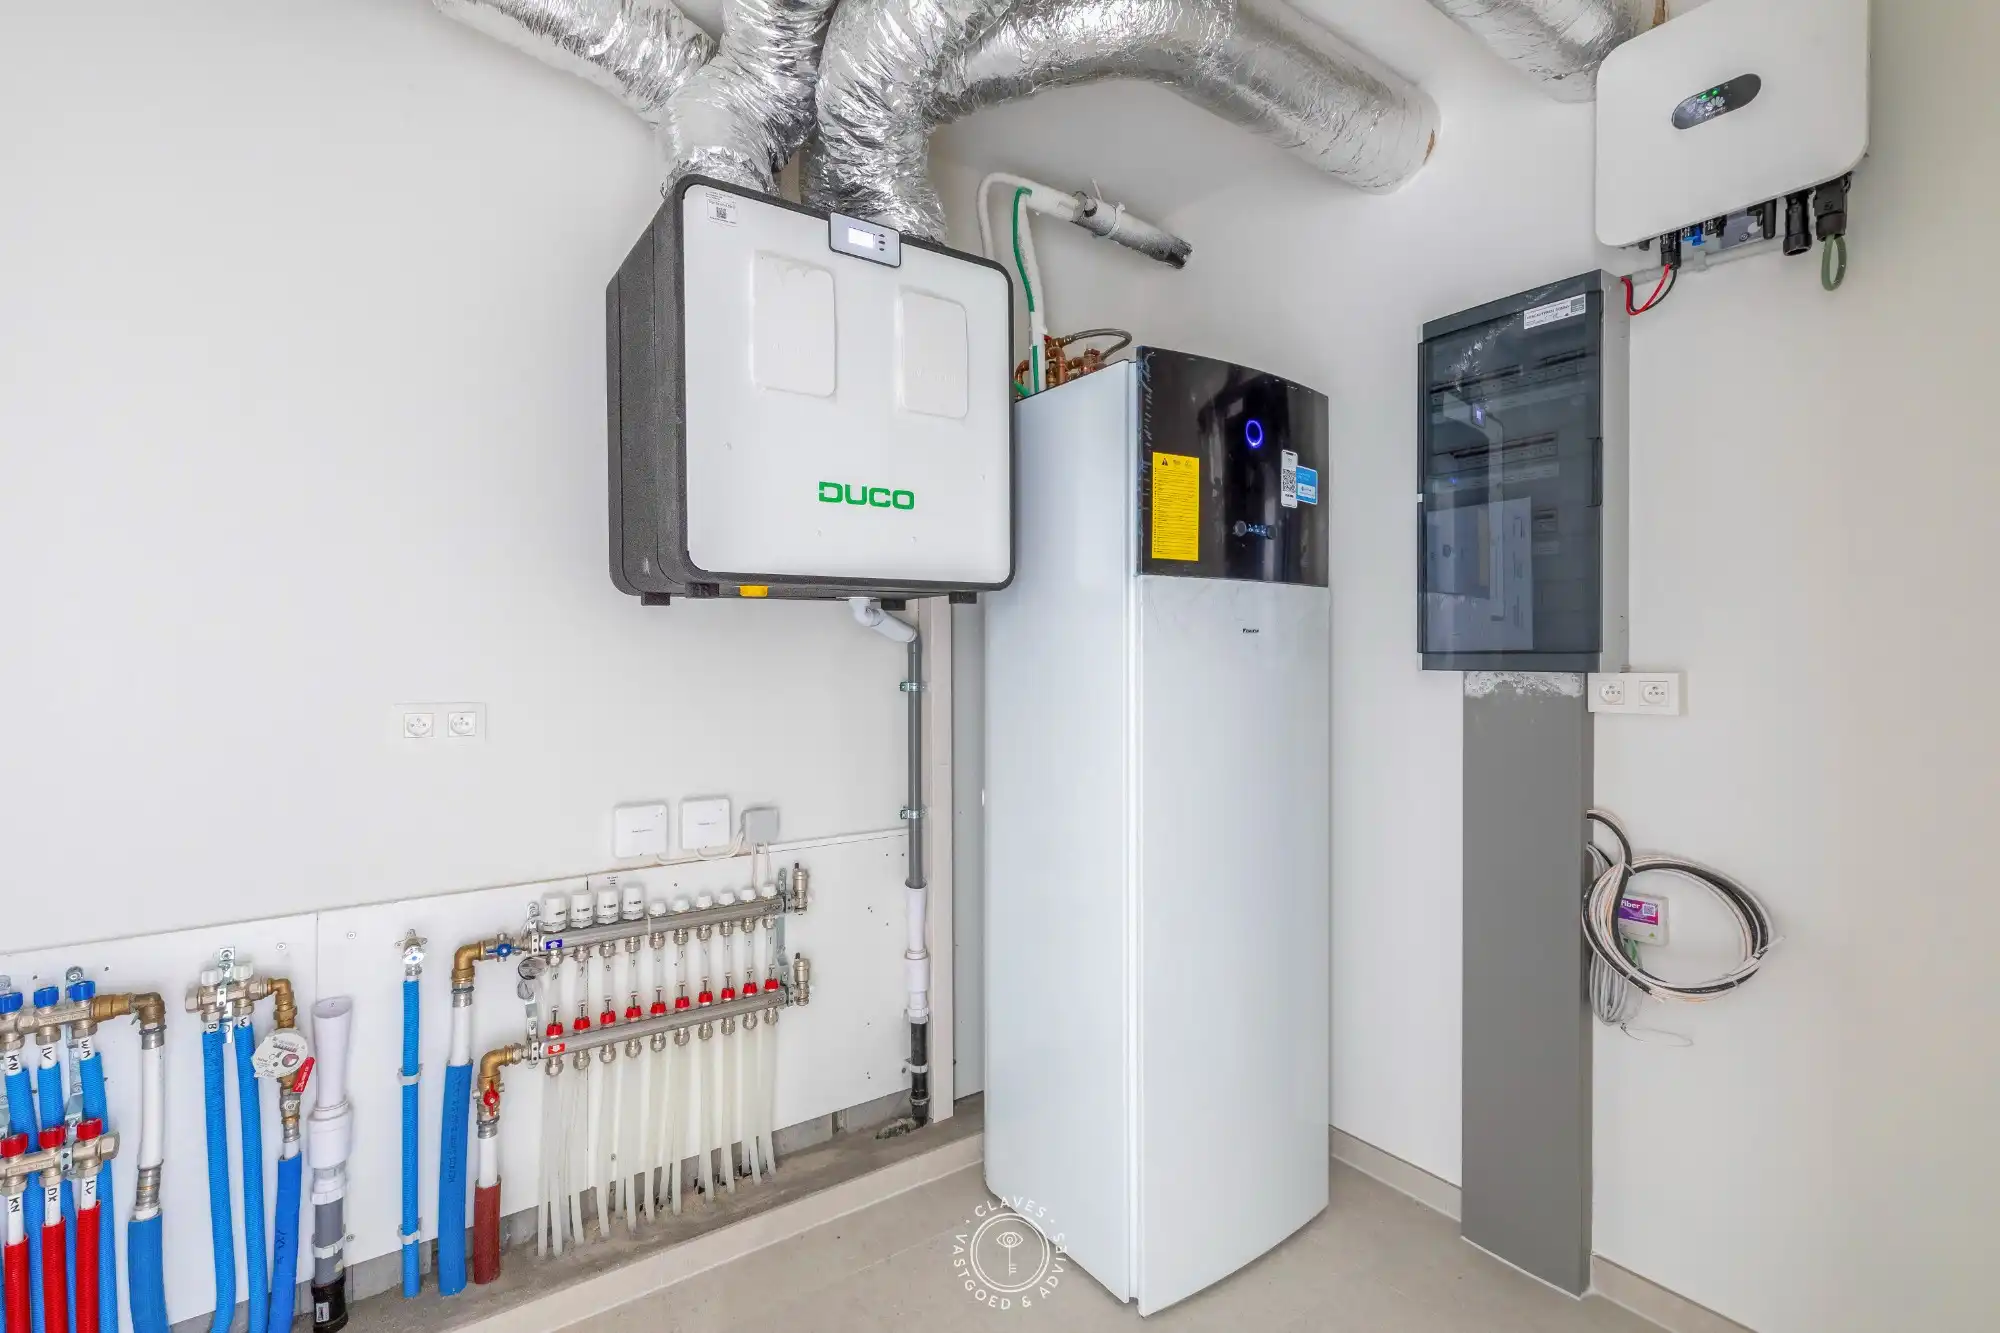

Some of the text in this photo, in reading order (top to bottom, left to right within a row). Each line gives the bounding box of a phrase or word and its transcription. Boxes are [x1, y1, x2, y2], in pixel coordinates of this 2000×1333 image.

[818, 481, 915, 510] DUCO
[6, 1053, 20, 1071] KN
[47, 1187, 58, 1202] DK
[9, 1196, 21, 1213] KN
